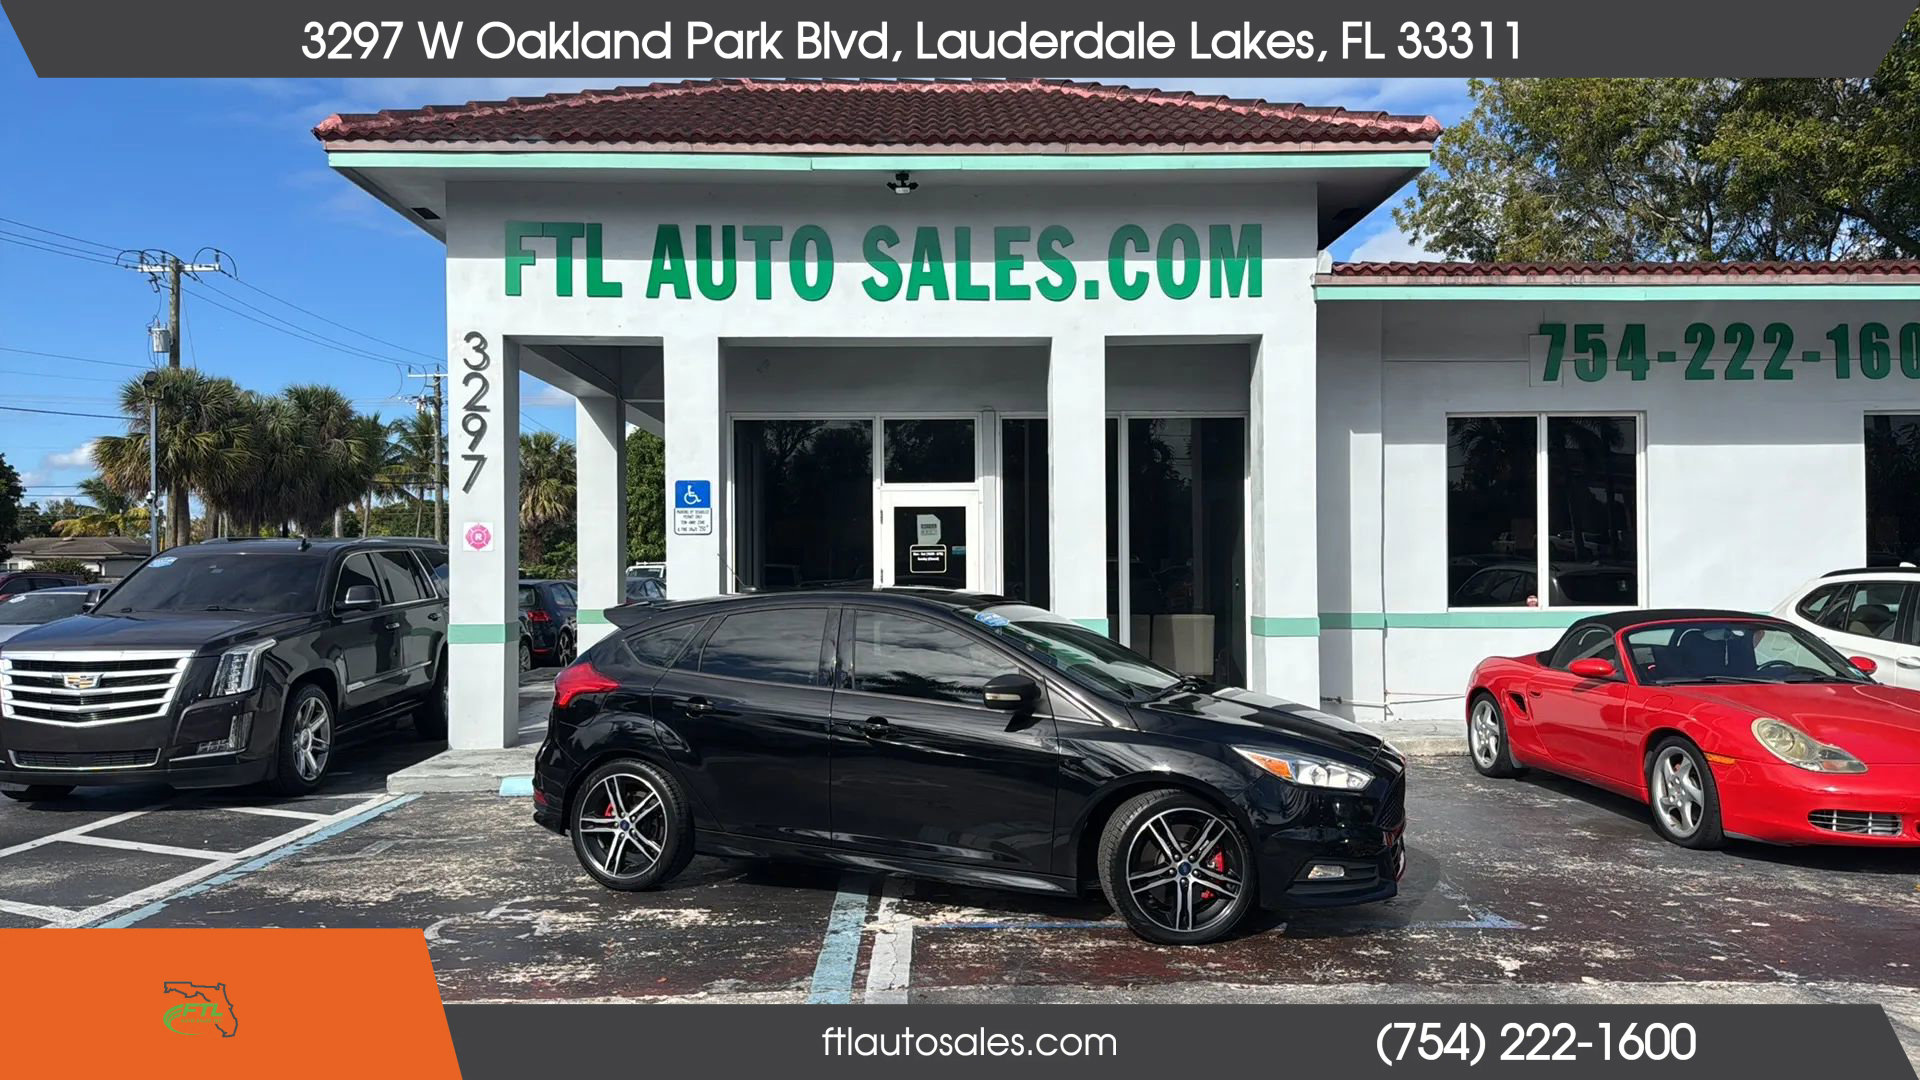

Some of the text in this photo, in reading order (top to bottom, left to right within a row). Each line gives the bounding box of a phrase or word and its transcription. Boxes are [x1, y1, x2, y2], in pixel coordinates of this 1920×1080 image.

[504, 220, 1264, 302] FTL AUTO SALES.COM
[461, 331, 491, 494] 3297
